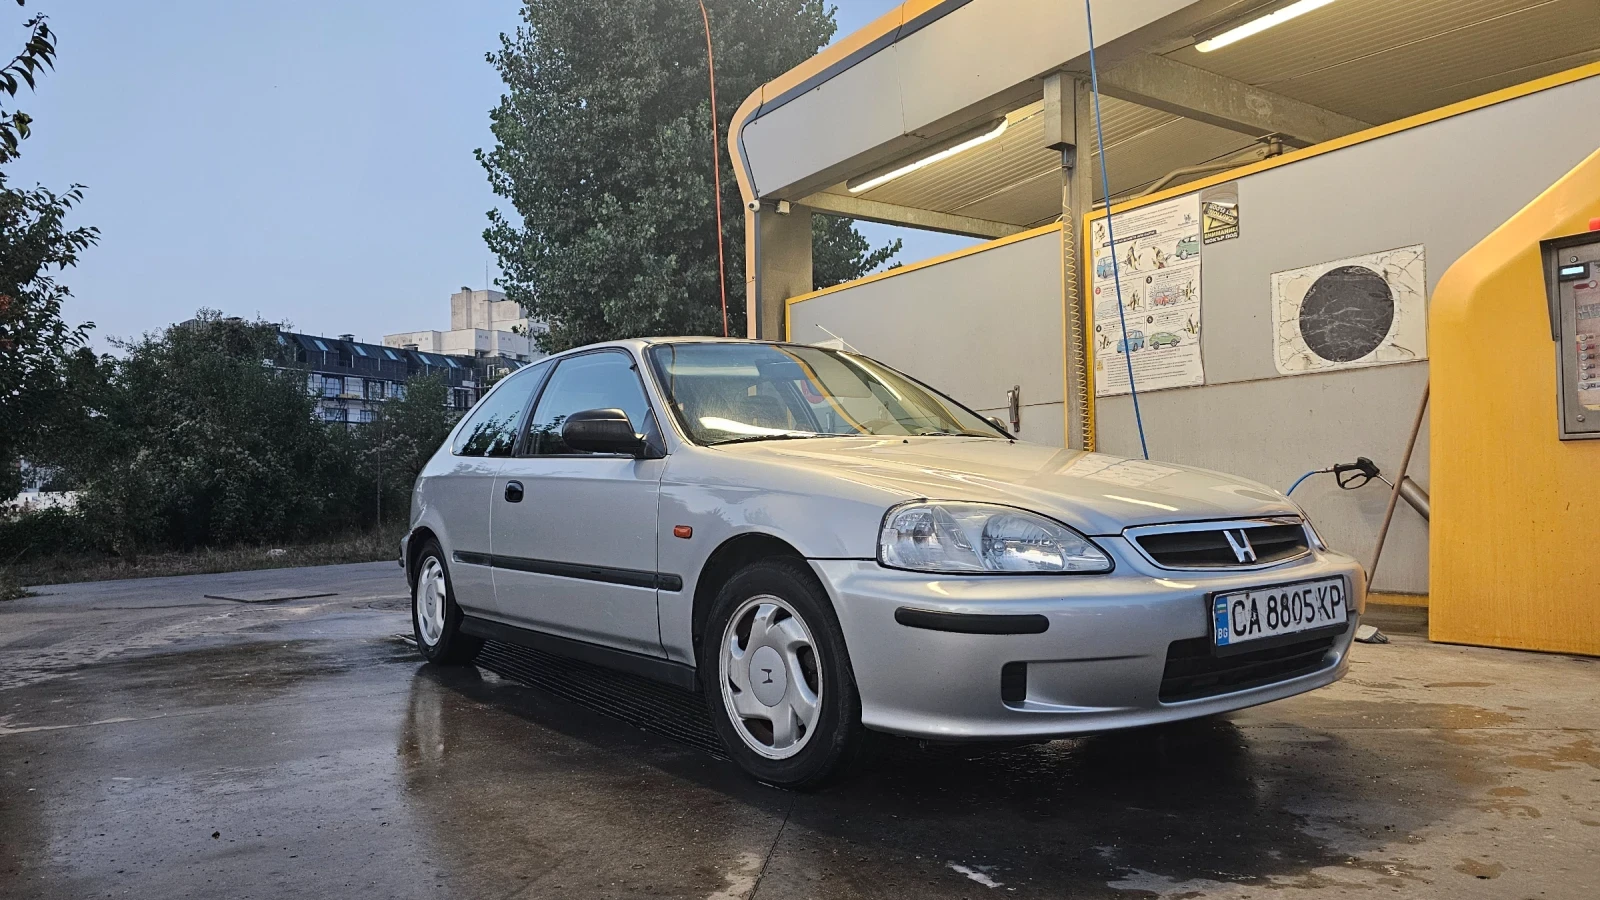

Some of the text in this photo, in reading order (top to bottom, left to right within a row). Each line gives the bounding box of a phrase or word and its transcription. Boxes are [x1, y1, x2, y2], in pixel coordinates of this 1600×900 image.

[1232, 585, 1341, 637] CA 8805 KP
[1217, 628, 1229, 639] BG
